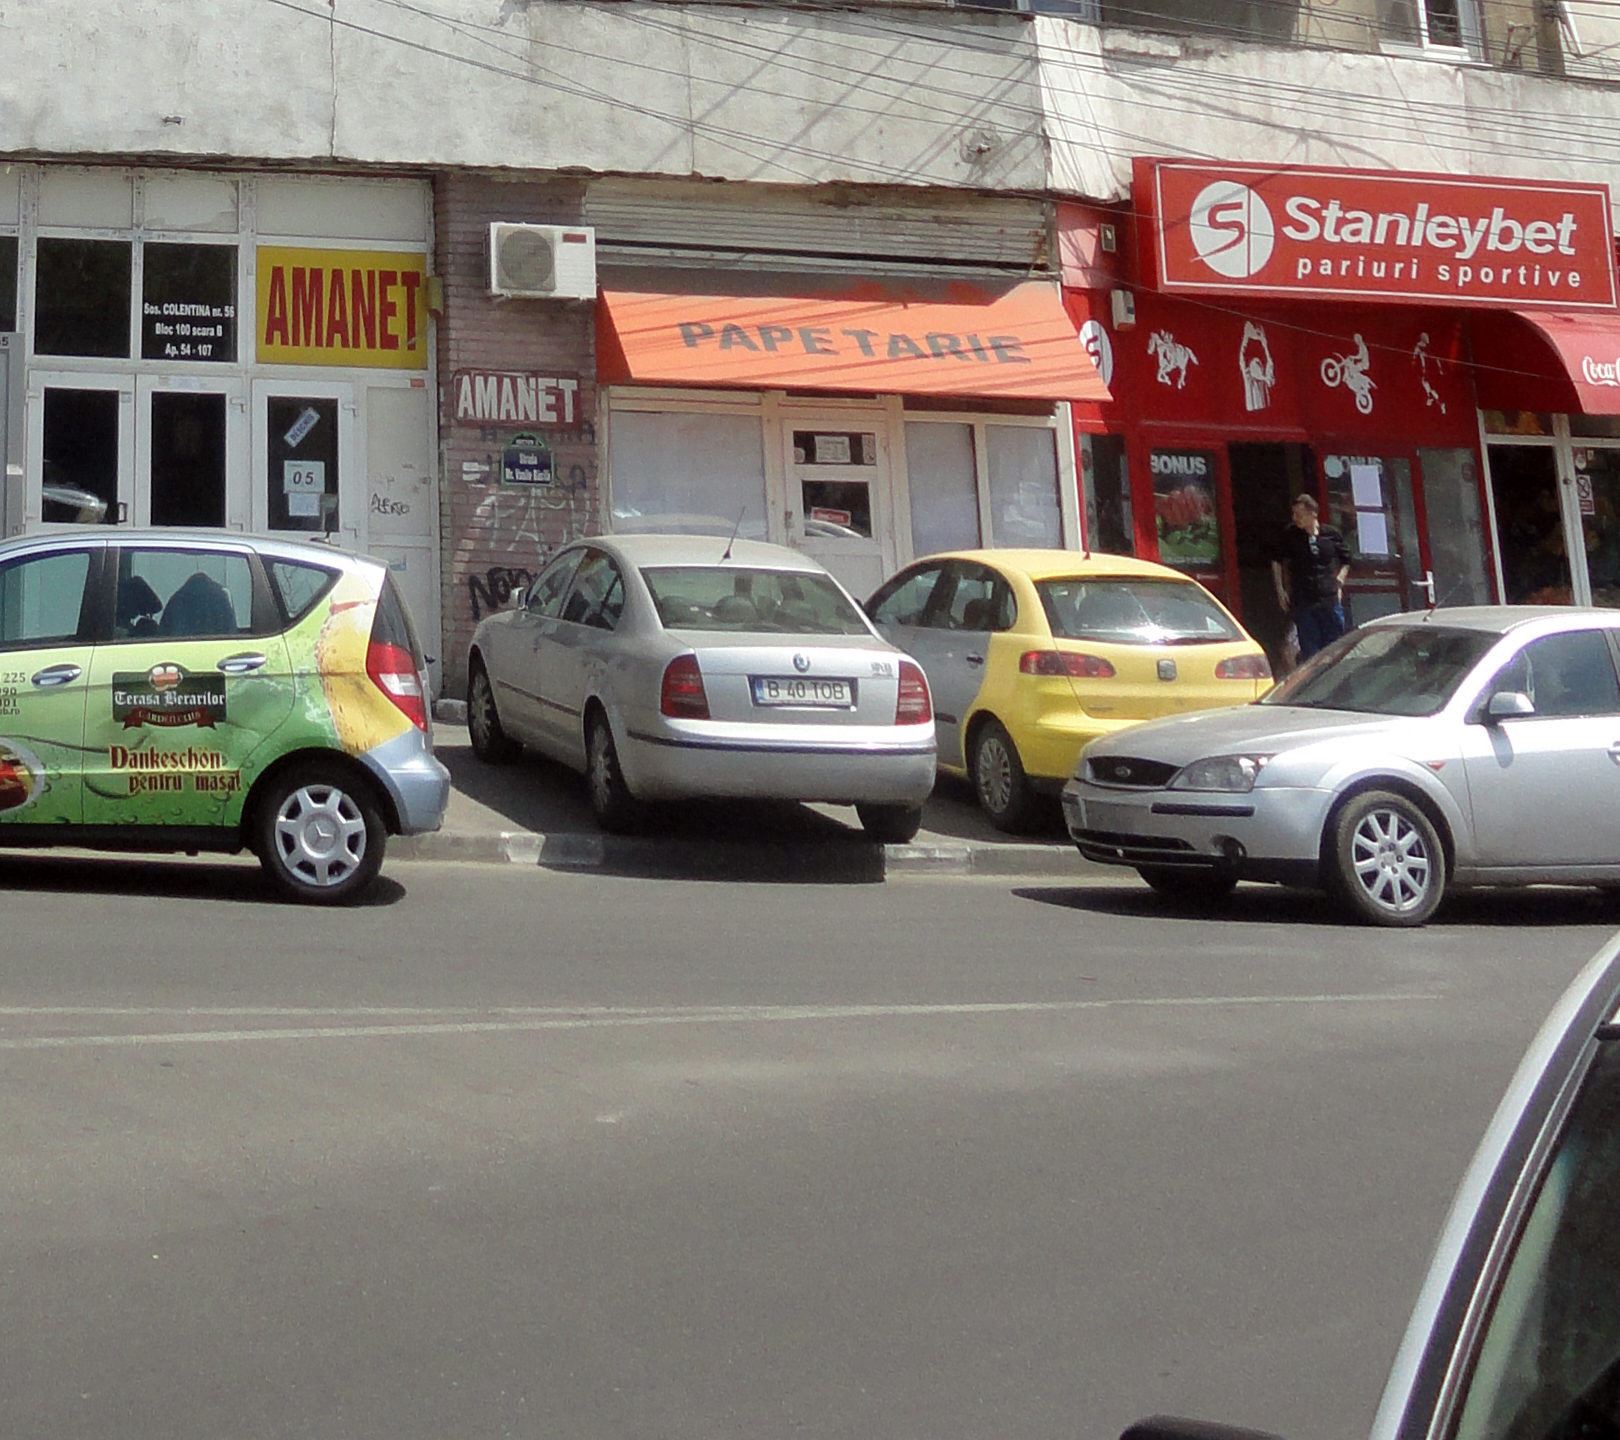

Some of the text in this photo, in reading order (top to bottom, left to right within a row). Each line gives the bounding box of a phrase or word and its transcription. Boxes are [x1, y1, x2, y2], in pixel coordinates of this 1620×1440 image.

[1282, 195, 1577, 259] Stanleybet
[1297, 255, 1582, 288] pariuri sportive
[163, 303, 211, 317] COLENTINA
[265, 266, 421, 351] AMANET
[155, 322, 174, 335] Bloc
[176, 323, 191, 335] 100
[192, 326, 215, 337] scara
[165, 342, 179, 358] Ap.
[180, 343, 191, 356] 54
[197, 344, 213, 356] 107
[679, 322, 1032, 364] PAPETARIE
[457, 374, 578, 423] AMANET
[3, 672, 26, 684] 225
[114, 690, 225, 707] Terasa Berarilor
[768, 680, 845, 700] B 40 TOB
[110, 745, 222, 770] Dankeschön
[128, 771, 183, 793] pentru
